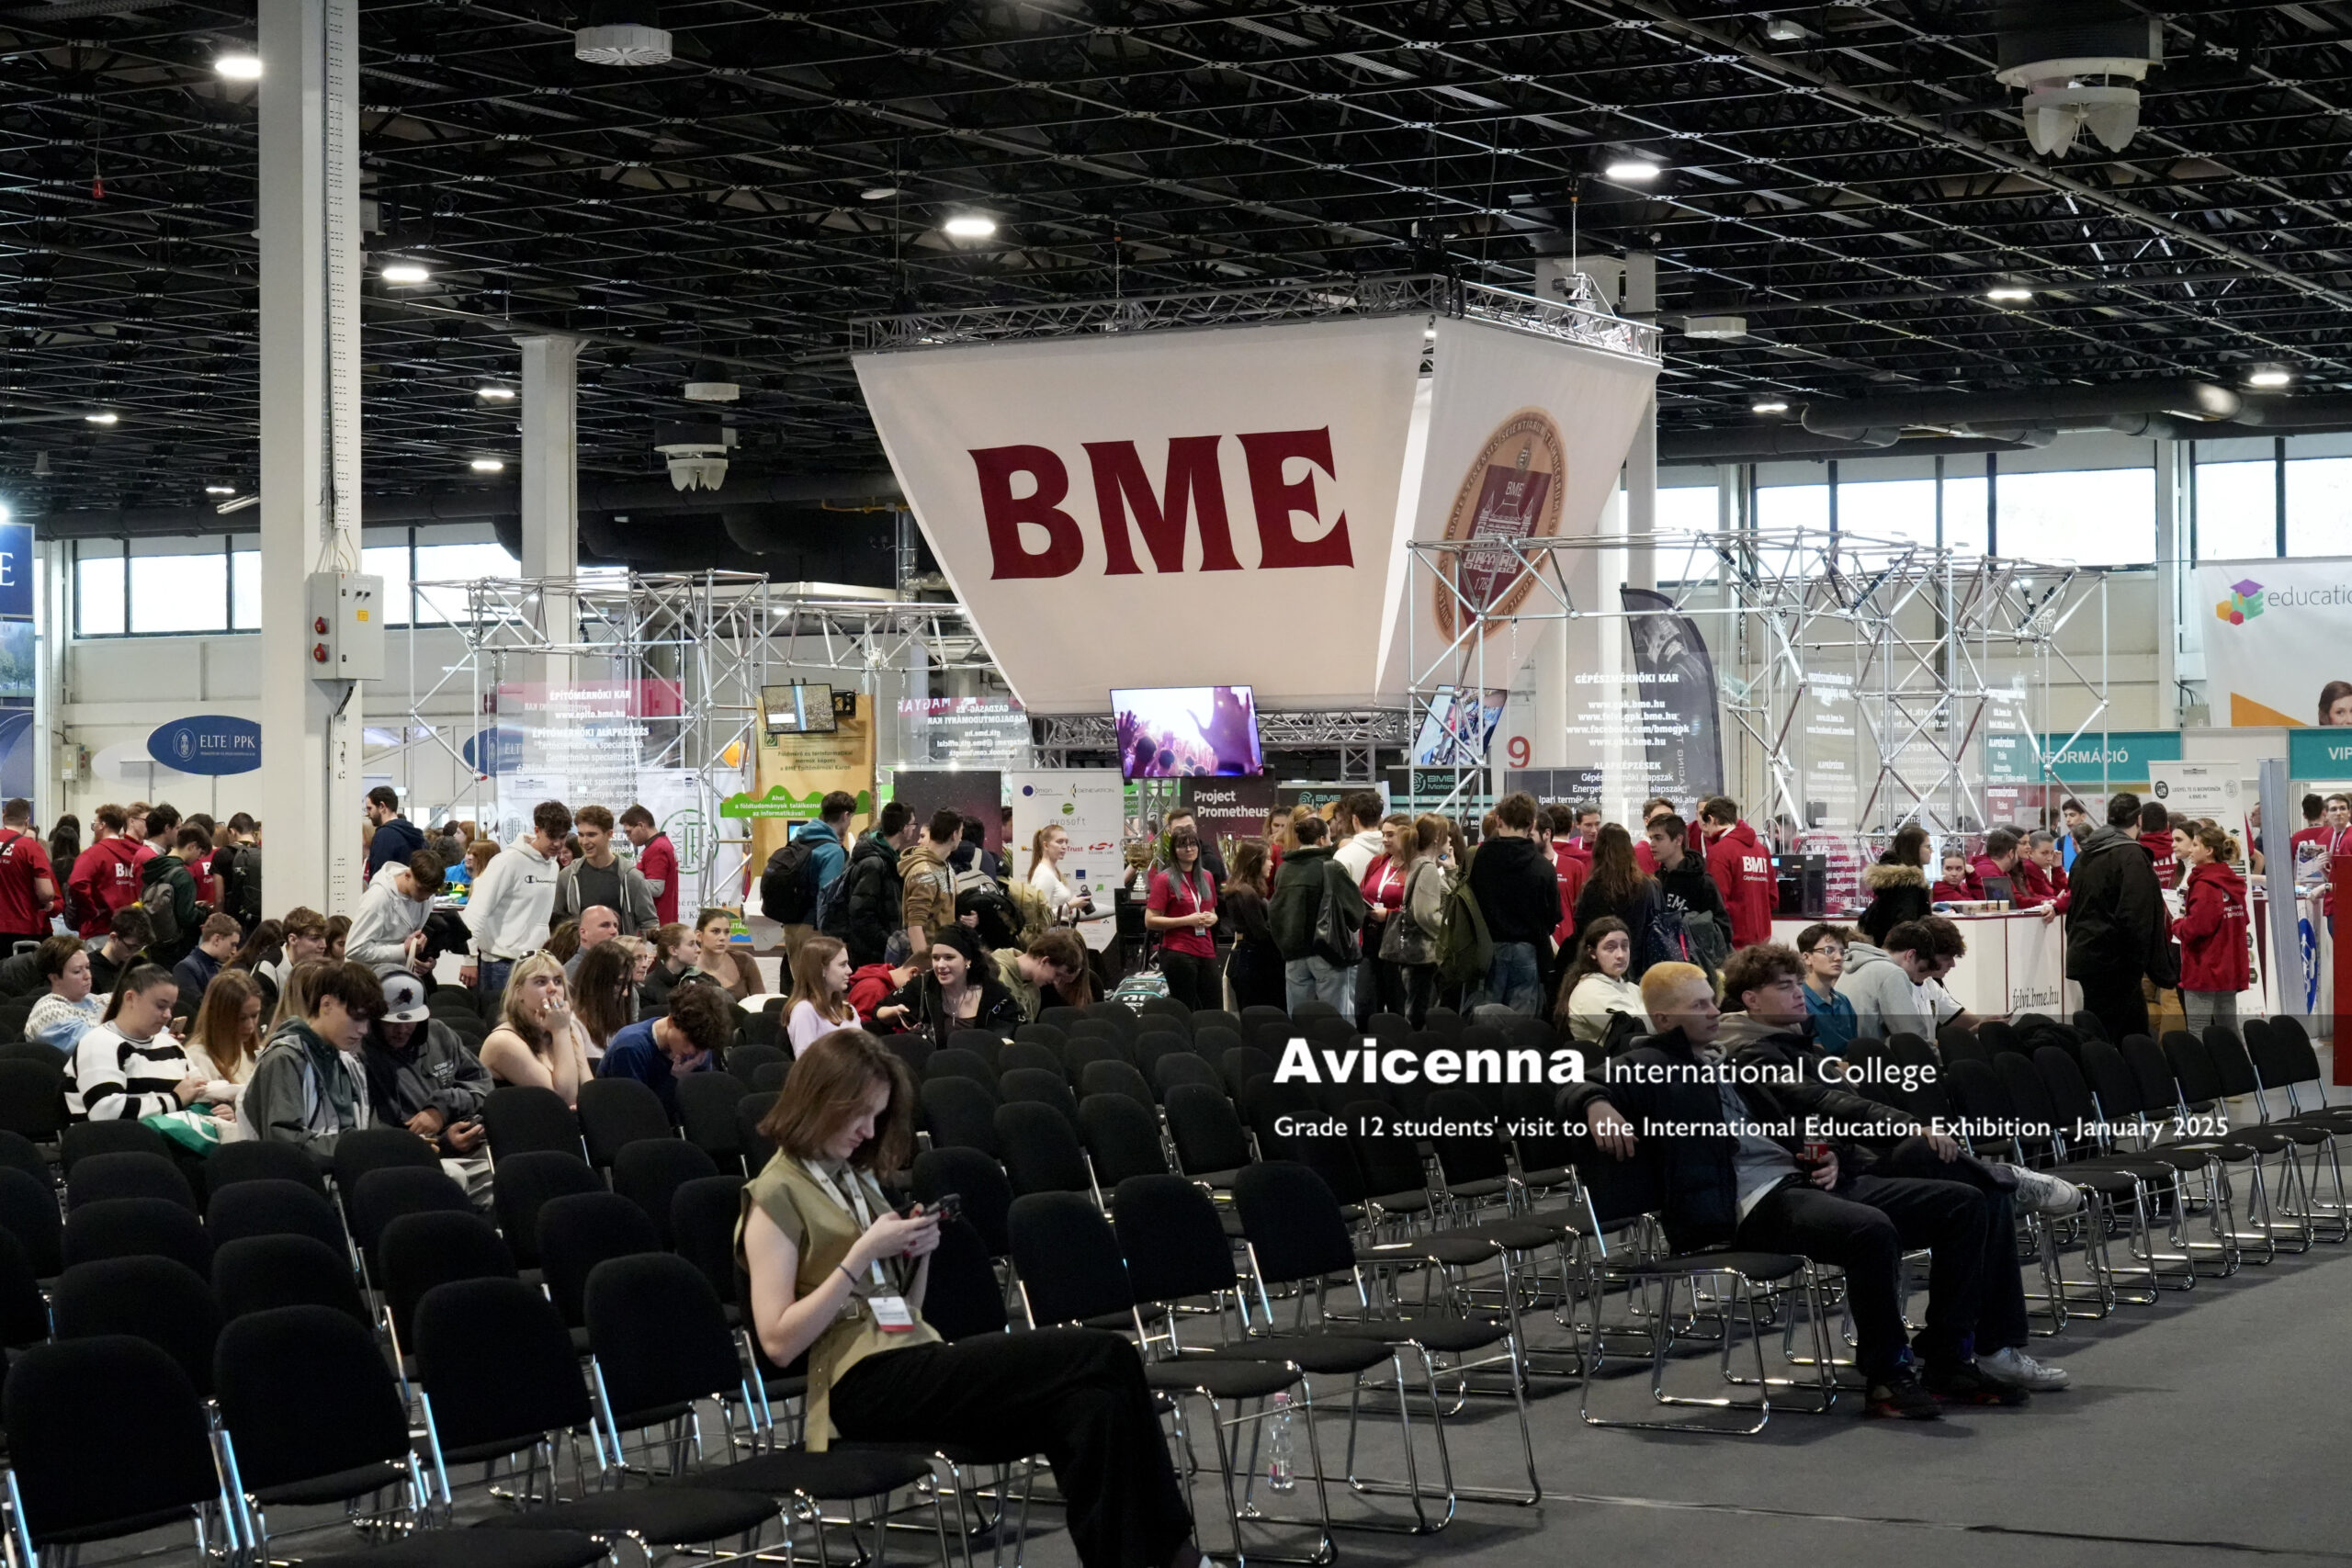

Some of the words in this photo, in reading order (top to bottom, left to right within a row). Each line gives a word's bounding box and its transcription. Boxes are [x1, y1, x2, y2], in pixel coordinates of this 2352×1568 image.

[1506, 480, 1524, 497] BME
[967, 424, 1355, 580] BME
[1575, 672, 1656, 683] GÉPÉSZMÉRNÖKI
[1658, 673, 1679, 683] KAR
[614, 690, 631, 700] KAR
[200, 735, 227, 748] ELTE
[234, 735, 255, 749] PPK
[504, 742, 524, 755] ELT
[1509, 736, 1531, 768] 9
[2328, 747, 2352, 761] VIP
[1641, 773, 1674, 784] alapszak
[1650, 784, 1682, 794] alapszak
[1193, 789, 1236, 803] Project
[740, 802, 787, 810] földtudományok
[1197, 806, 1270, 818] Prometheus
[1050, 817, 1086, 826] evosoft
[2012, 986, 2059, 1010] felvi.bme.hu
